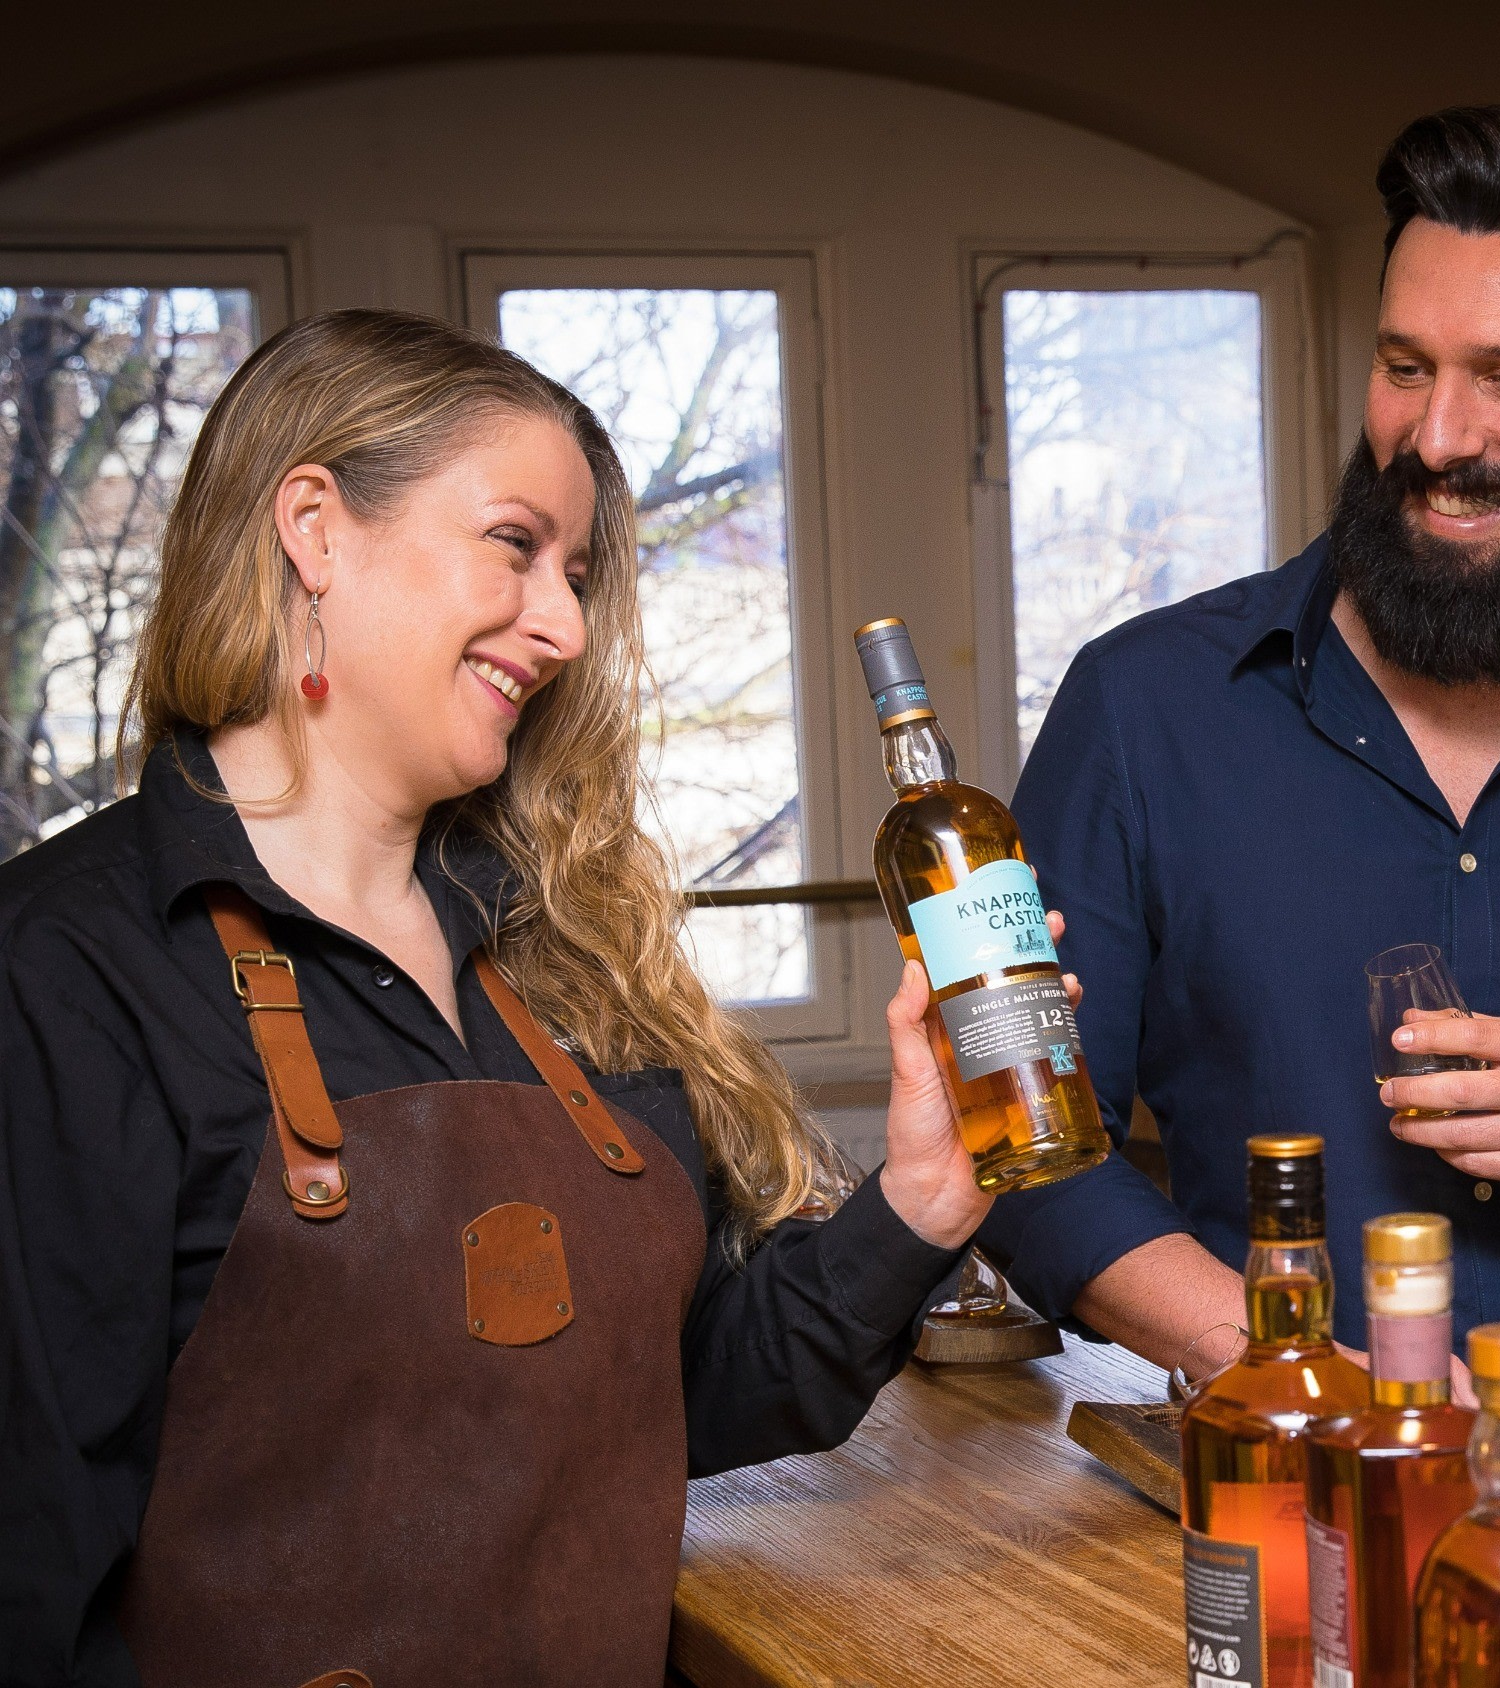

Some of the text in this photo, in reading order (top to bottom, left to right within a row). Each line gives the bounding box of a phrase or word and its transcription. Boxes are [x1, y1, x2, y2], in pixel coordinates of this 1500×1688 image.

[896, 687, 927, 697] KNAPPOG
[957, 892, 1043, 919] KNAPPOG
[988, 910, 1046, 930] CASTLE
[1019, 983, 1038, 991] TRIPLE
[971, 997, 1011, 1015] SINGLE
[1013, 990, 1039, 1004] MALT
[1041, 989, 1061, 999] IRISH
[1035, 1008, 1064, 1029] 12
